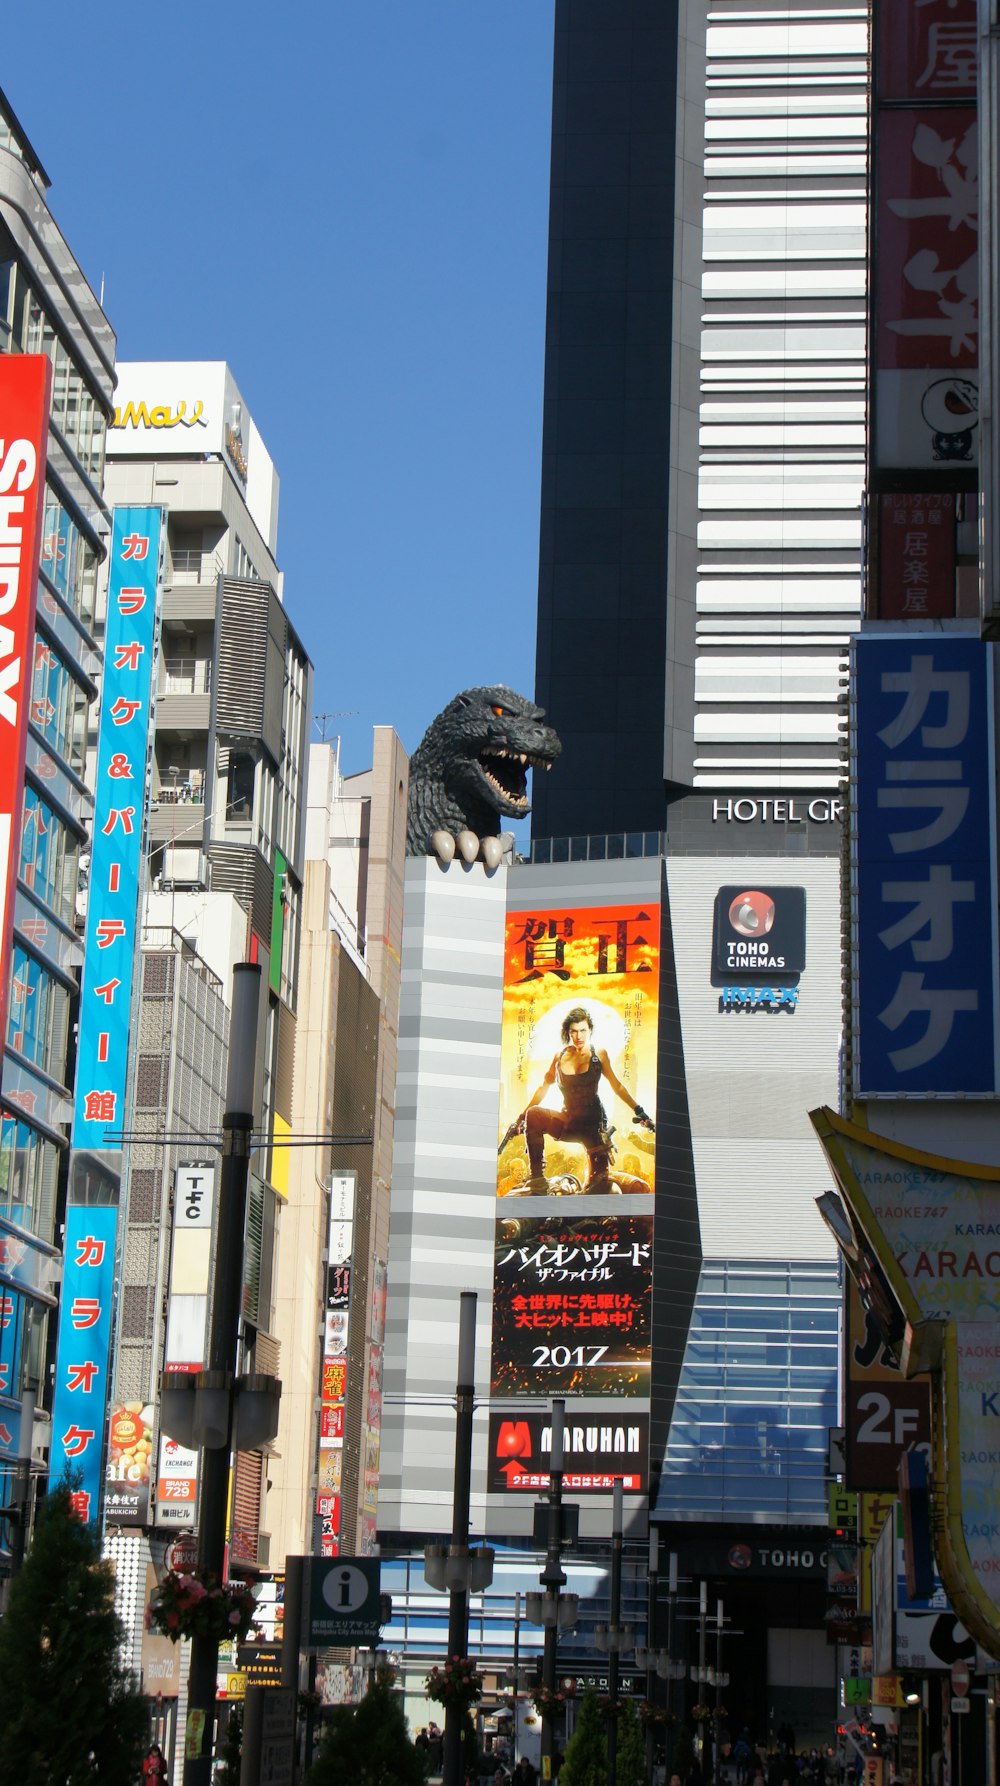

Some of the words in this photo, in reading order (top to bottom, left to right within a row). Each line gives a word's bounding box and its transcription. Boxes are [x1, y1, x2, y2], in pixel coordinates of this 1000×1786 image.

[915, 0, 978, 88] 屋
[893, 510, 942, 525] 居酒屋
[902, 532, 929, 612] 居楽屋
[713, 799, 802, 821] HOTEL
[809, 799, 845, 821] GR
[876, 655, 979, 1073] カラオケ
[513, 911, 654, 985] 賀正
[727, 942, 770, 957] TOHO
[727, 957, 786, 968] CINEMAS
[722, 986, 798, 1004] IMAX
[497, 1242, 652, 1273] バイオハザード
[535, 1266, 616, 1283] ザ・ファイナル
[511, 1293, 640, 1311] 全世界に先駆け、
[515, 1310, 633, 1329] 大ヒット上映中!
[532, 1345, 610, 1368] 2017
[324, 1365, 344, 1396] 麻雀
[856, 1392, 920, 1444] 2F
[540, 1427, 640, 1452] MARUHAN
[165, 1486, 191, 1498] 729
[106, 1508, 138, 1516] ABUKICHO
[757, 1549, 815, 1568] TOHO
